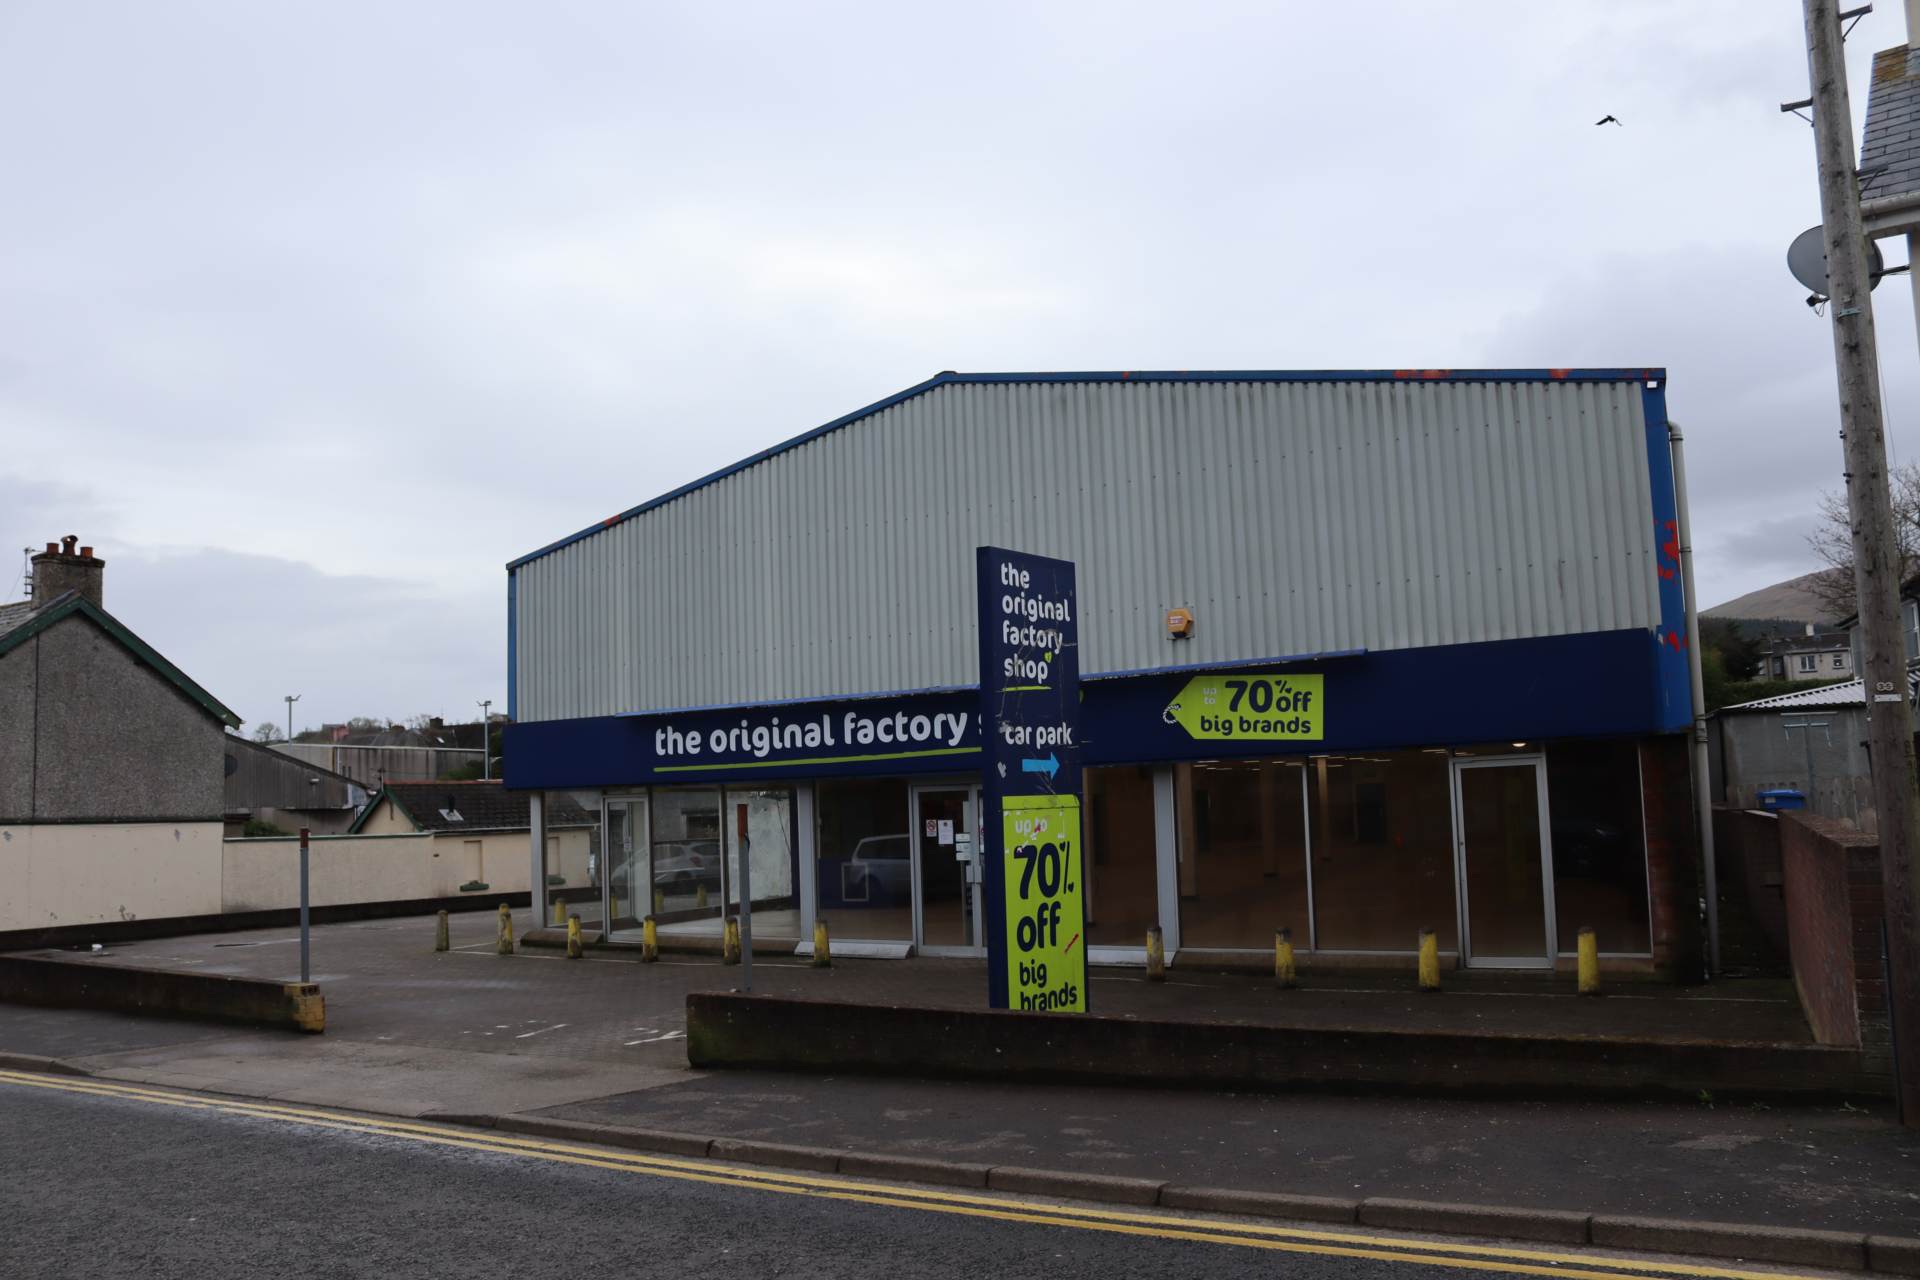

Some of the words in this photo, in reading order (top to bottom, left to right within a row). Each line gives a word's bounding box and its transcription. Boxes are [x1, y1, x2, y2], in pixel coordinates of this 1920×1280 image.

[1000, 561, 1030, 590] the
[1001, 593, 1070, 622] original
[1002, 619, 1063, 654] factory
[1003, 653, 1049, 684] shop
[1225, 679, 1292, 713] 70%
[1276, 690, 1313, 713] off
[655, 725, 701, 756] the
[709, 712, 835, 758] original
[843, 710, 968, 746] factory
[1004, 723, 1032, 746] car
[1035, 721, 1073, 750] park
[1200, 715, 1233, 736] big
[1239, 716, 1312, 734] brands
[1014, 818, 1031, 836] up
[1013, 841, 1075, 900] 70%
[1016, 901, 1061, 952] off
[1019, 959, 1047, 988] big
[1020, 983, 1077, 1012] brands
